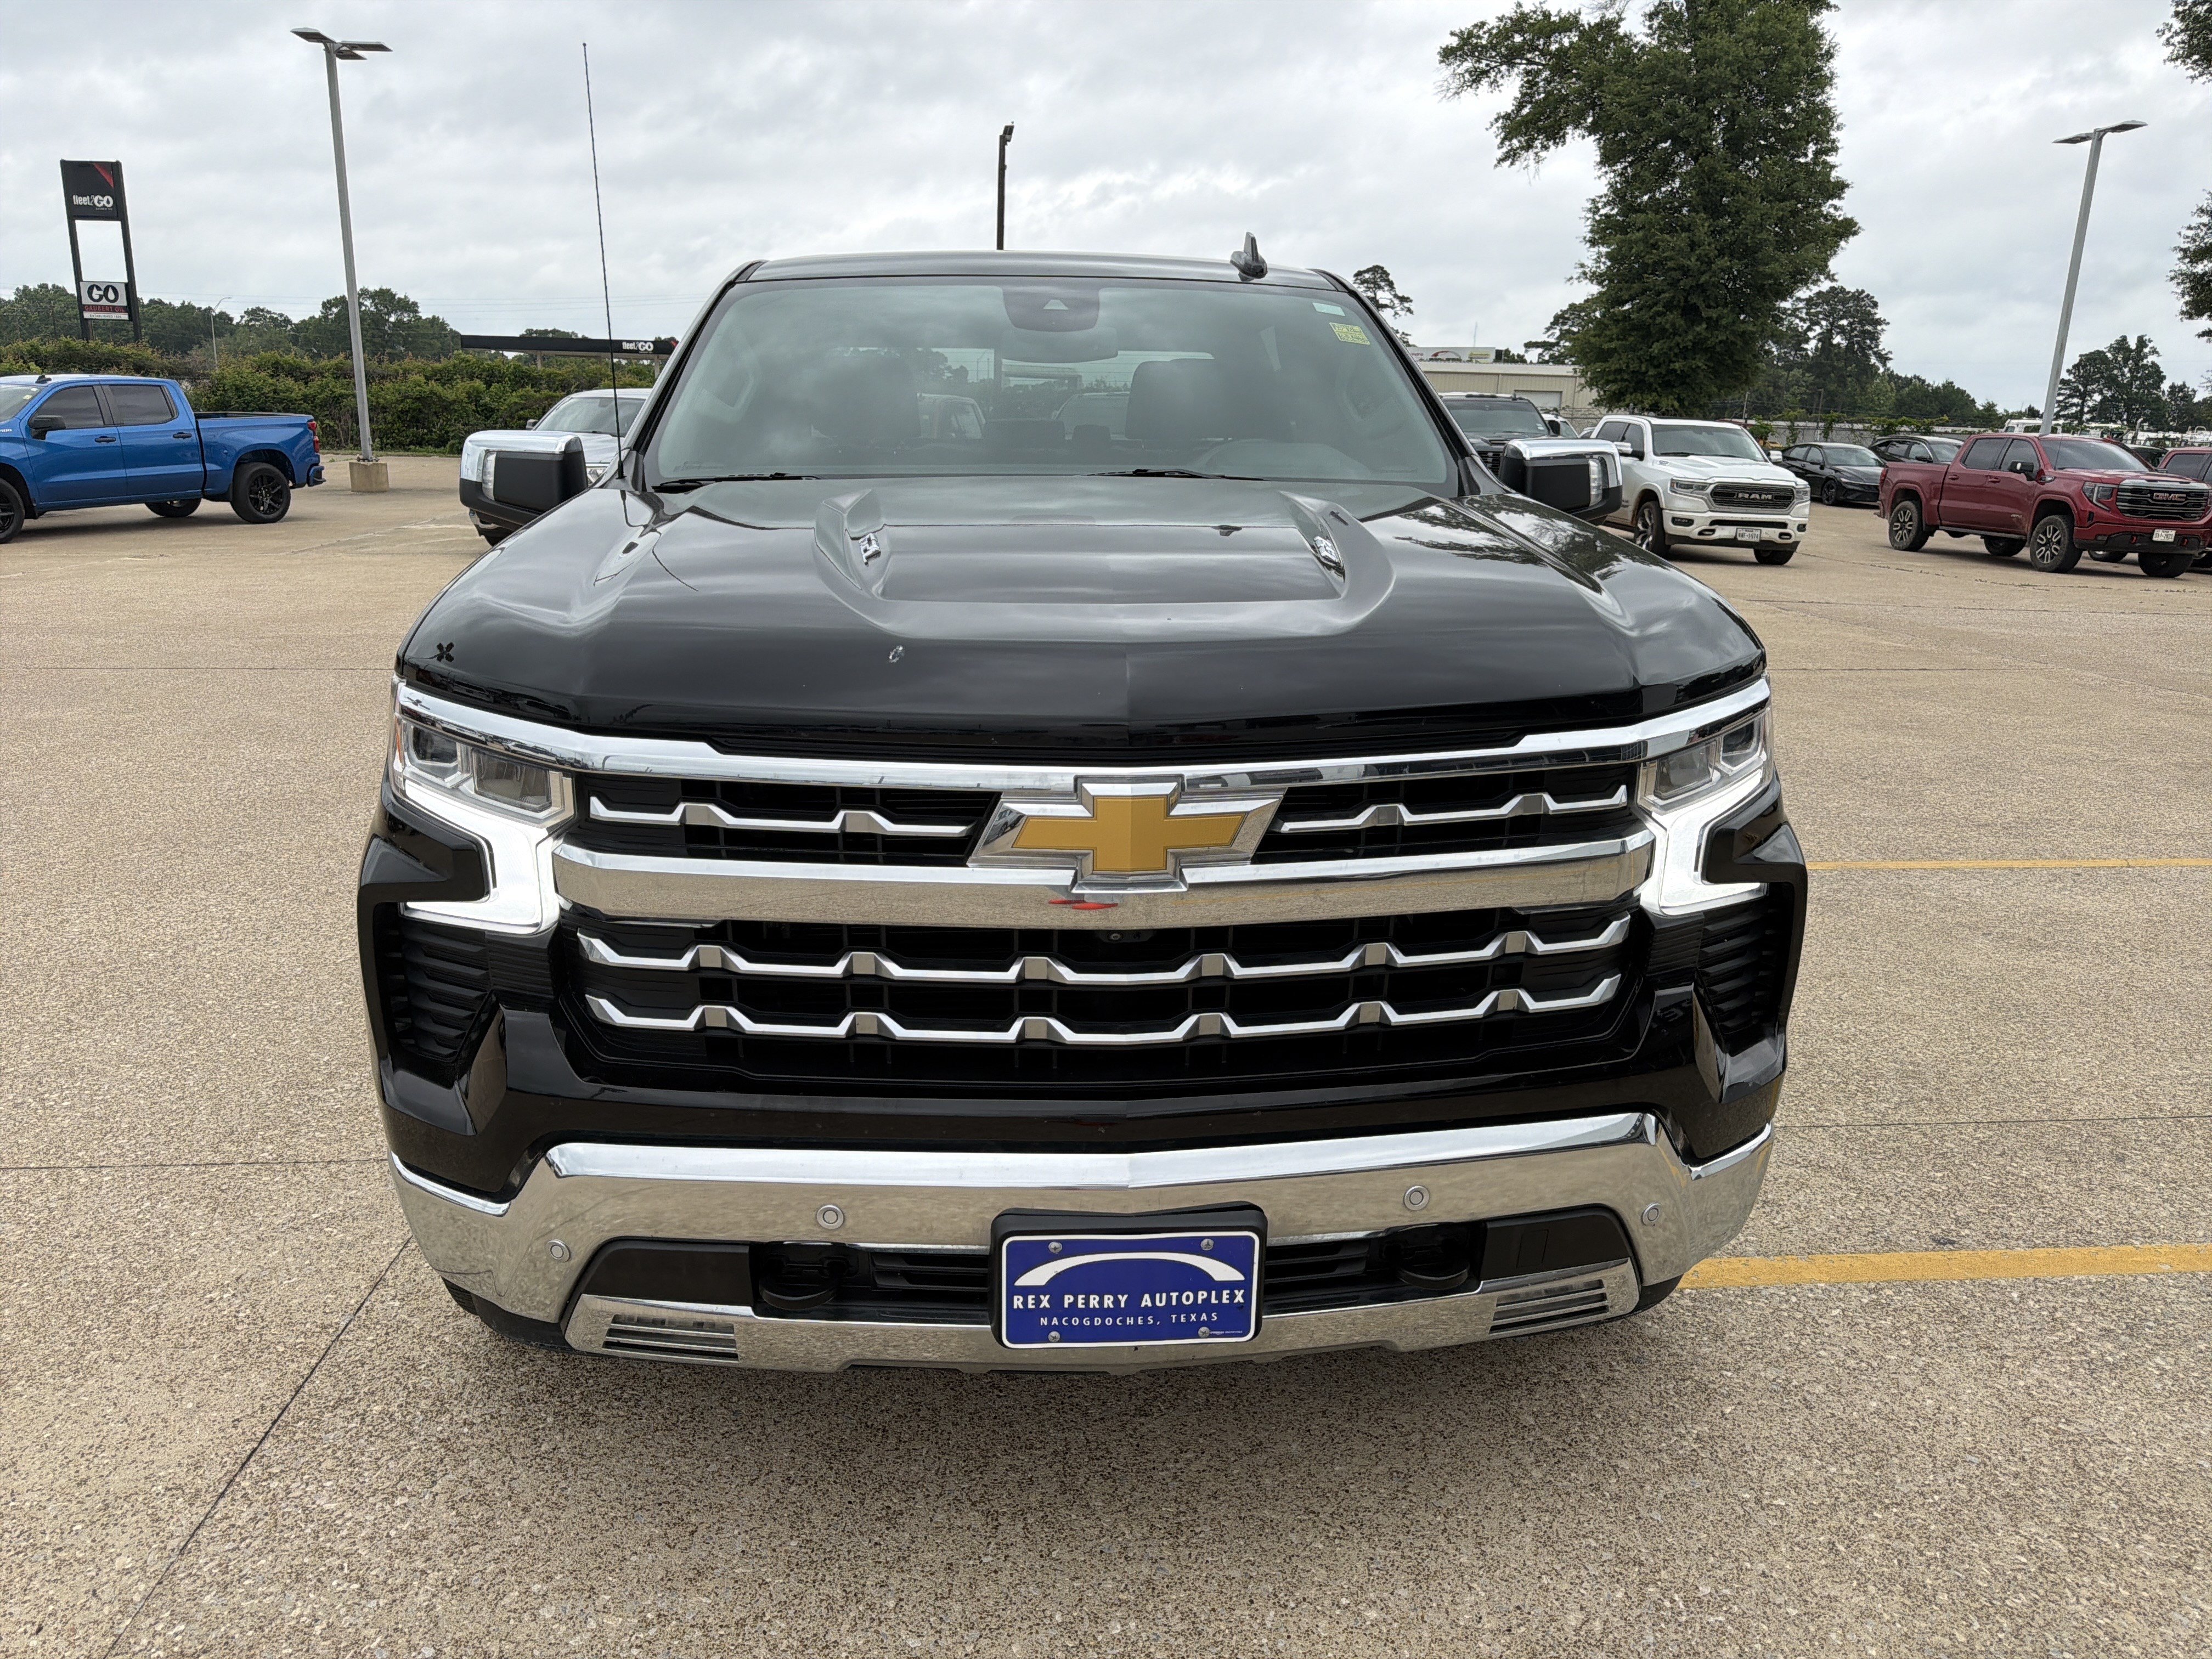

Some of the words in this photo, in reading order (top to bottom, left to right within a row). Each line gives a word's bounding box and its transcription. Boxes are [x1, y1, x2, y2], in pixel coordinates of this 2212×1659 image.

[87, 284, 119, 303] GO
[2153, 493, 2186, 501] GMC
[1013, 1295, 1050, 1309] REX
[1064, 1294, 1129, 1308] PERRY
[1141, 1289, 1245, 1308] AUTOPLEX
[1040, 1316, 1161, 1327] NACOGDOCHES,
[1171, 1312, 1218, 1323] TEXAS
